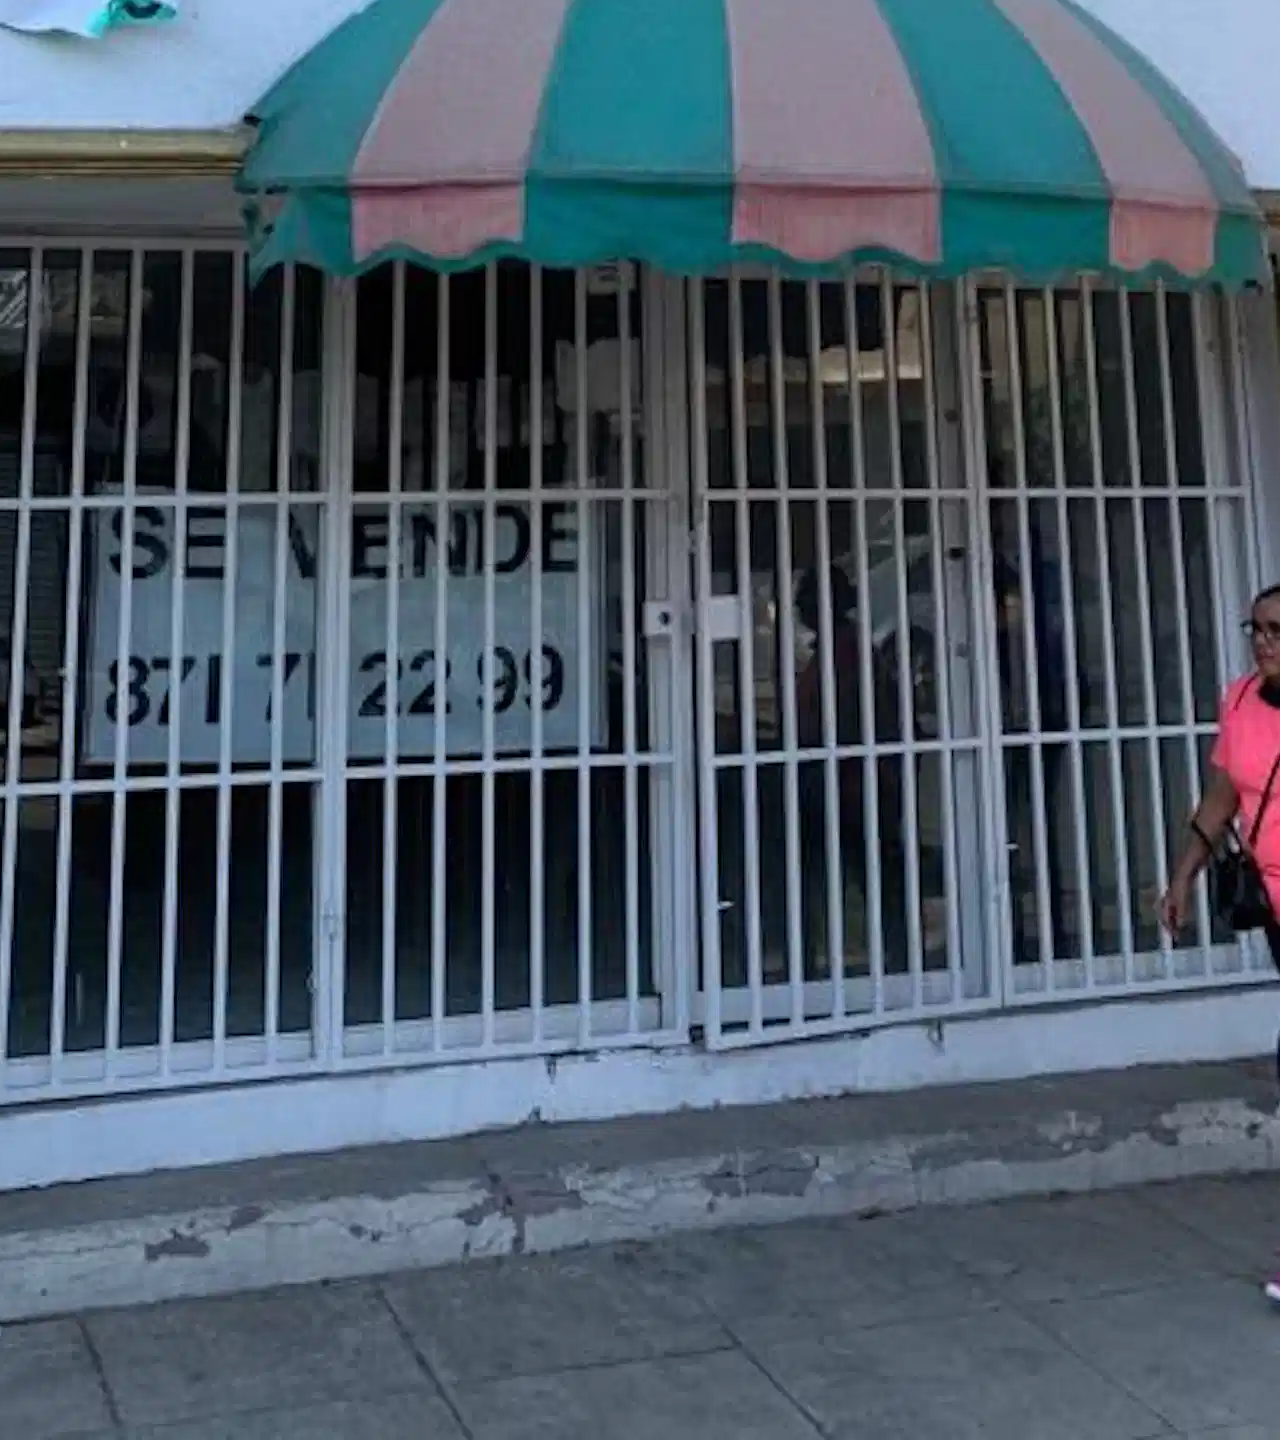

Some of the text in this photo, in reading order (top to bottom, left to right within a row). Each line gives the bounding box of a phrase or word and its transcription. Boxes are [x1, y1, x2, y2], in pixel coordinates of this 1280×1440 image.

[109, 504, 227, 579] SE
[106, 653, 222, 727] 871
[358, 649, 452, 717] 22
[477, 645, 564, 714] 99
